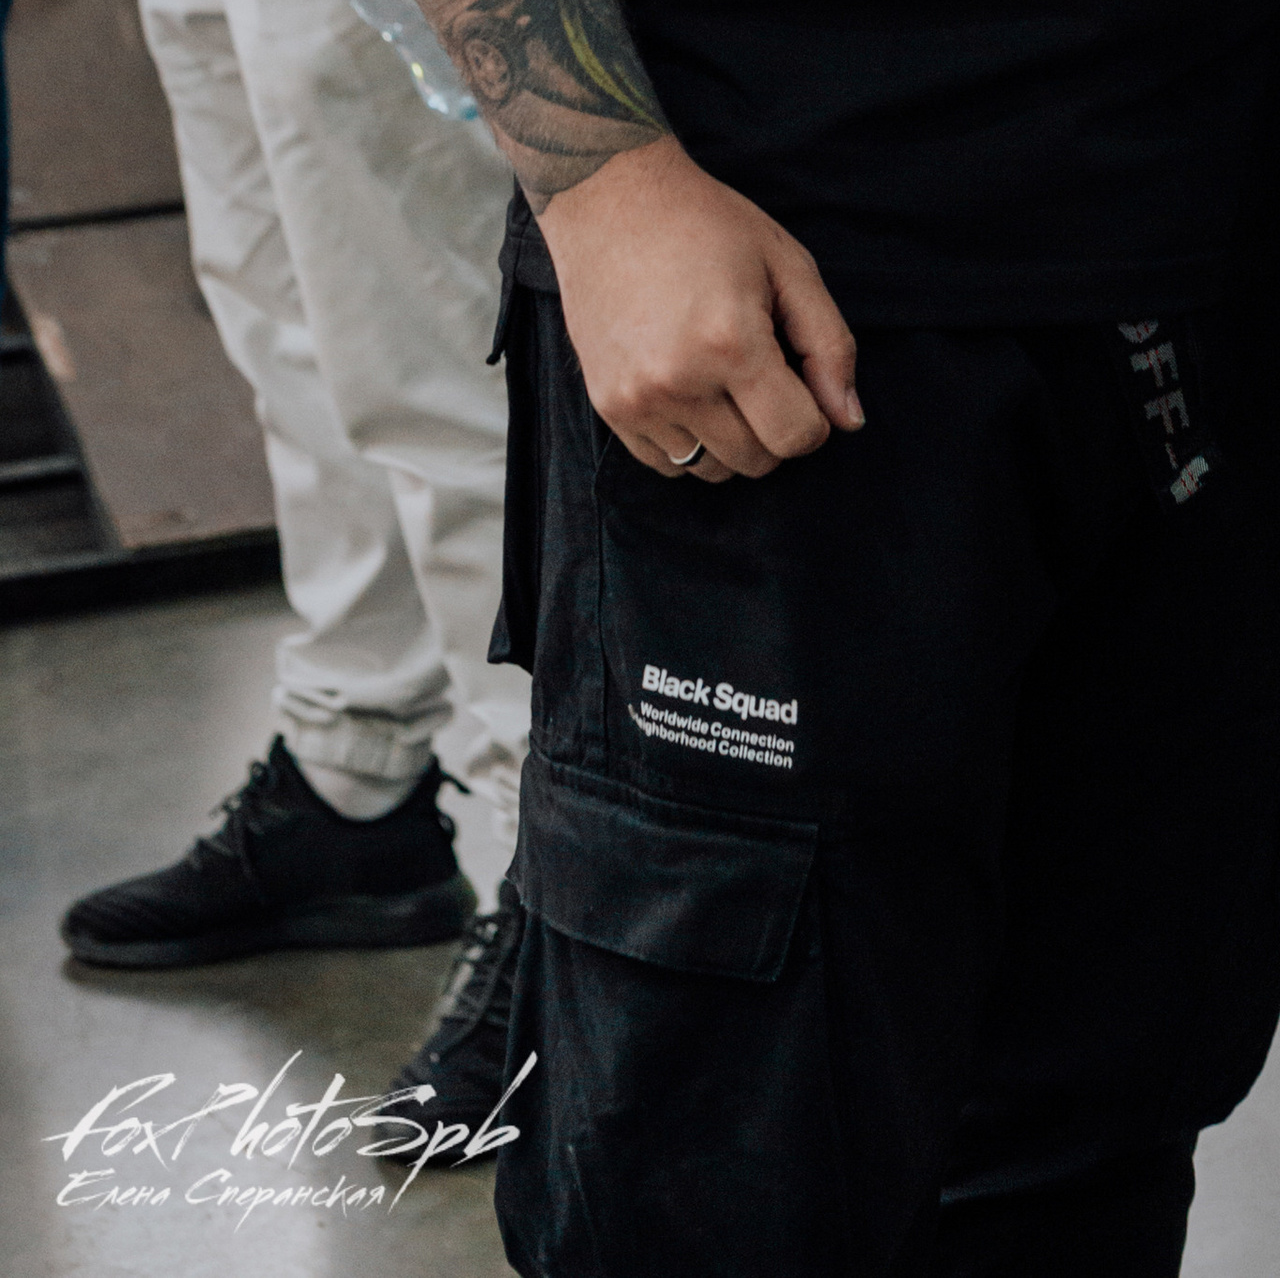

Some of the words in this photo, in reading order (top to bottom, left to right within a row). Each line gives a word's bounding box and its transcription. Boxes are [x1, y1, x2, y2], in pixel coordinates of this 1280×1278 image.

[642, 663, 711, 706] Black
[713, 682, 798, 725] Squad
[640, 700, 709, 735] Worldwide
[711, 722, 795, 753] Connection
[718, 740, 793, 769] Collection
